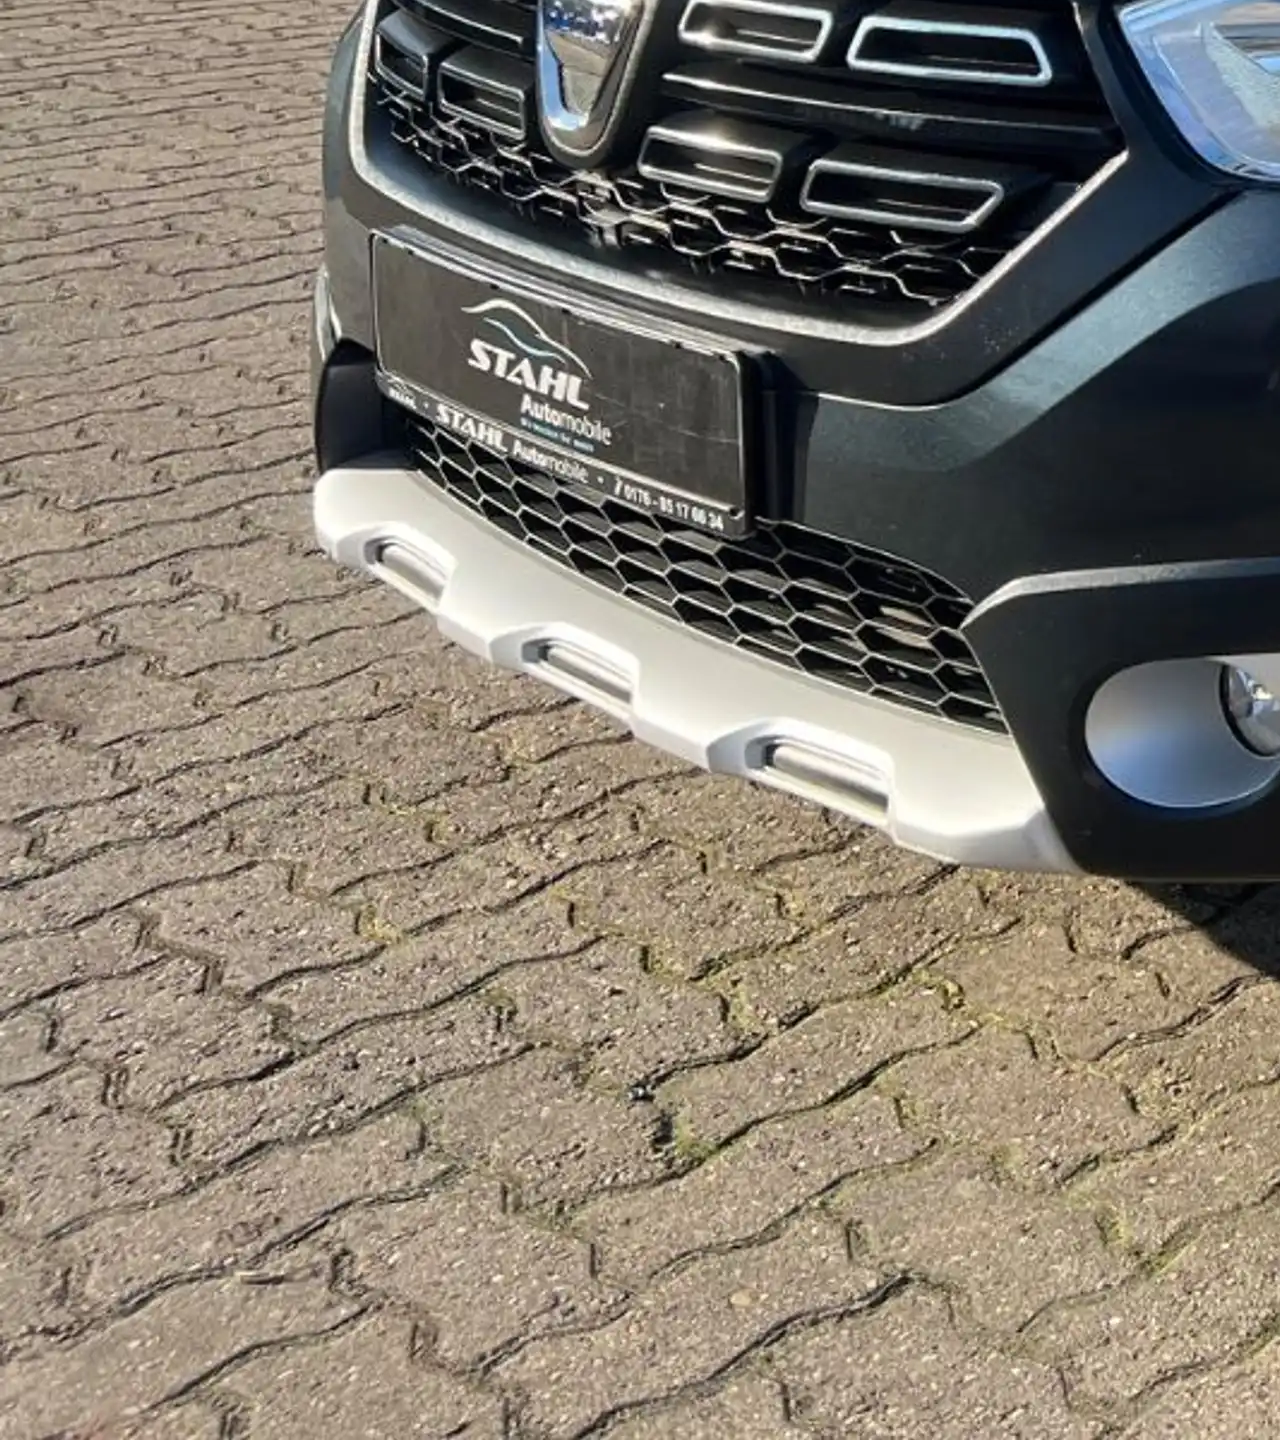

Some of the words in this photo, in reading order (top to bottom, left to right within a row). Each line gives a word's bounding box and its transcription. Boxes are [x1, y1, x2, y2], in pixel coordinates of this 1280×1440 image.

[468, 338, 590, 410] STAHL
[436, 403, 508, 453] STAHL
[520, 393, 612, 446] Automobile
